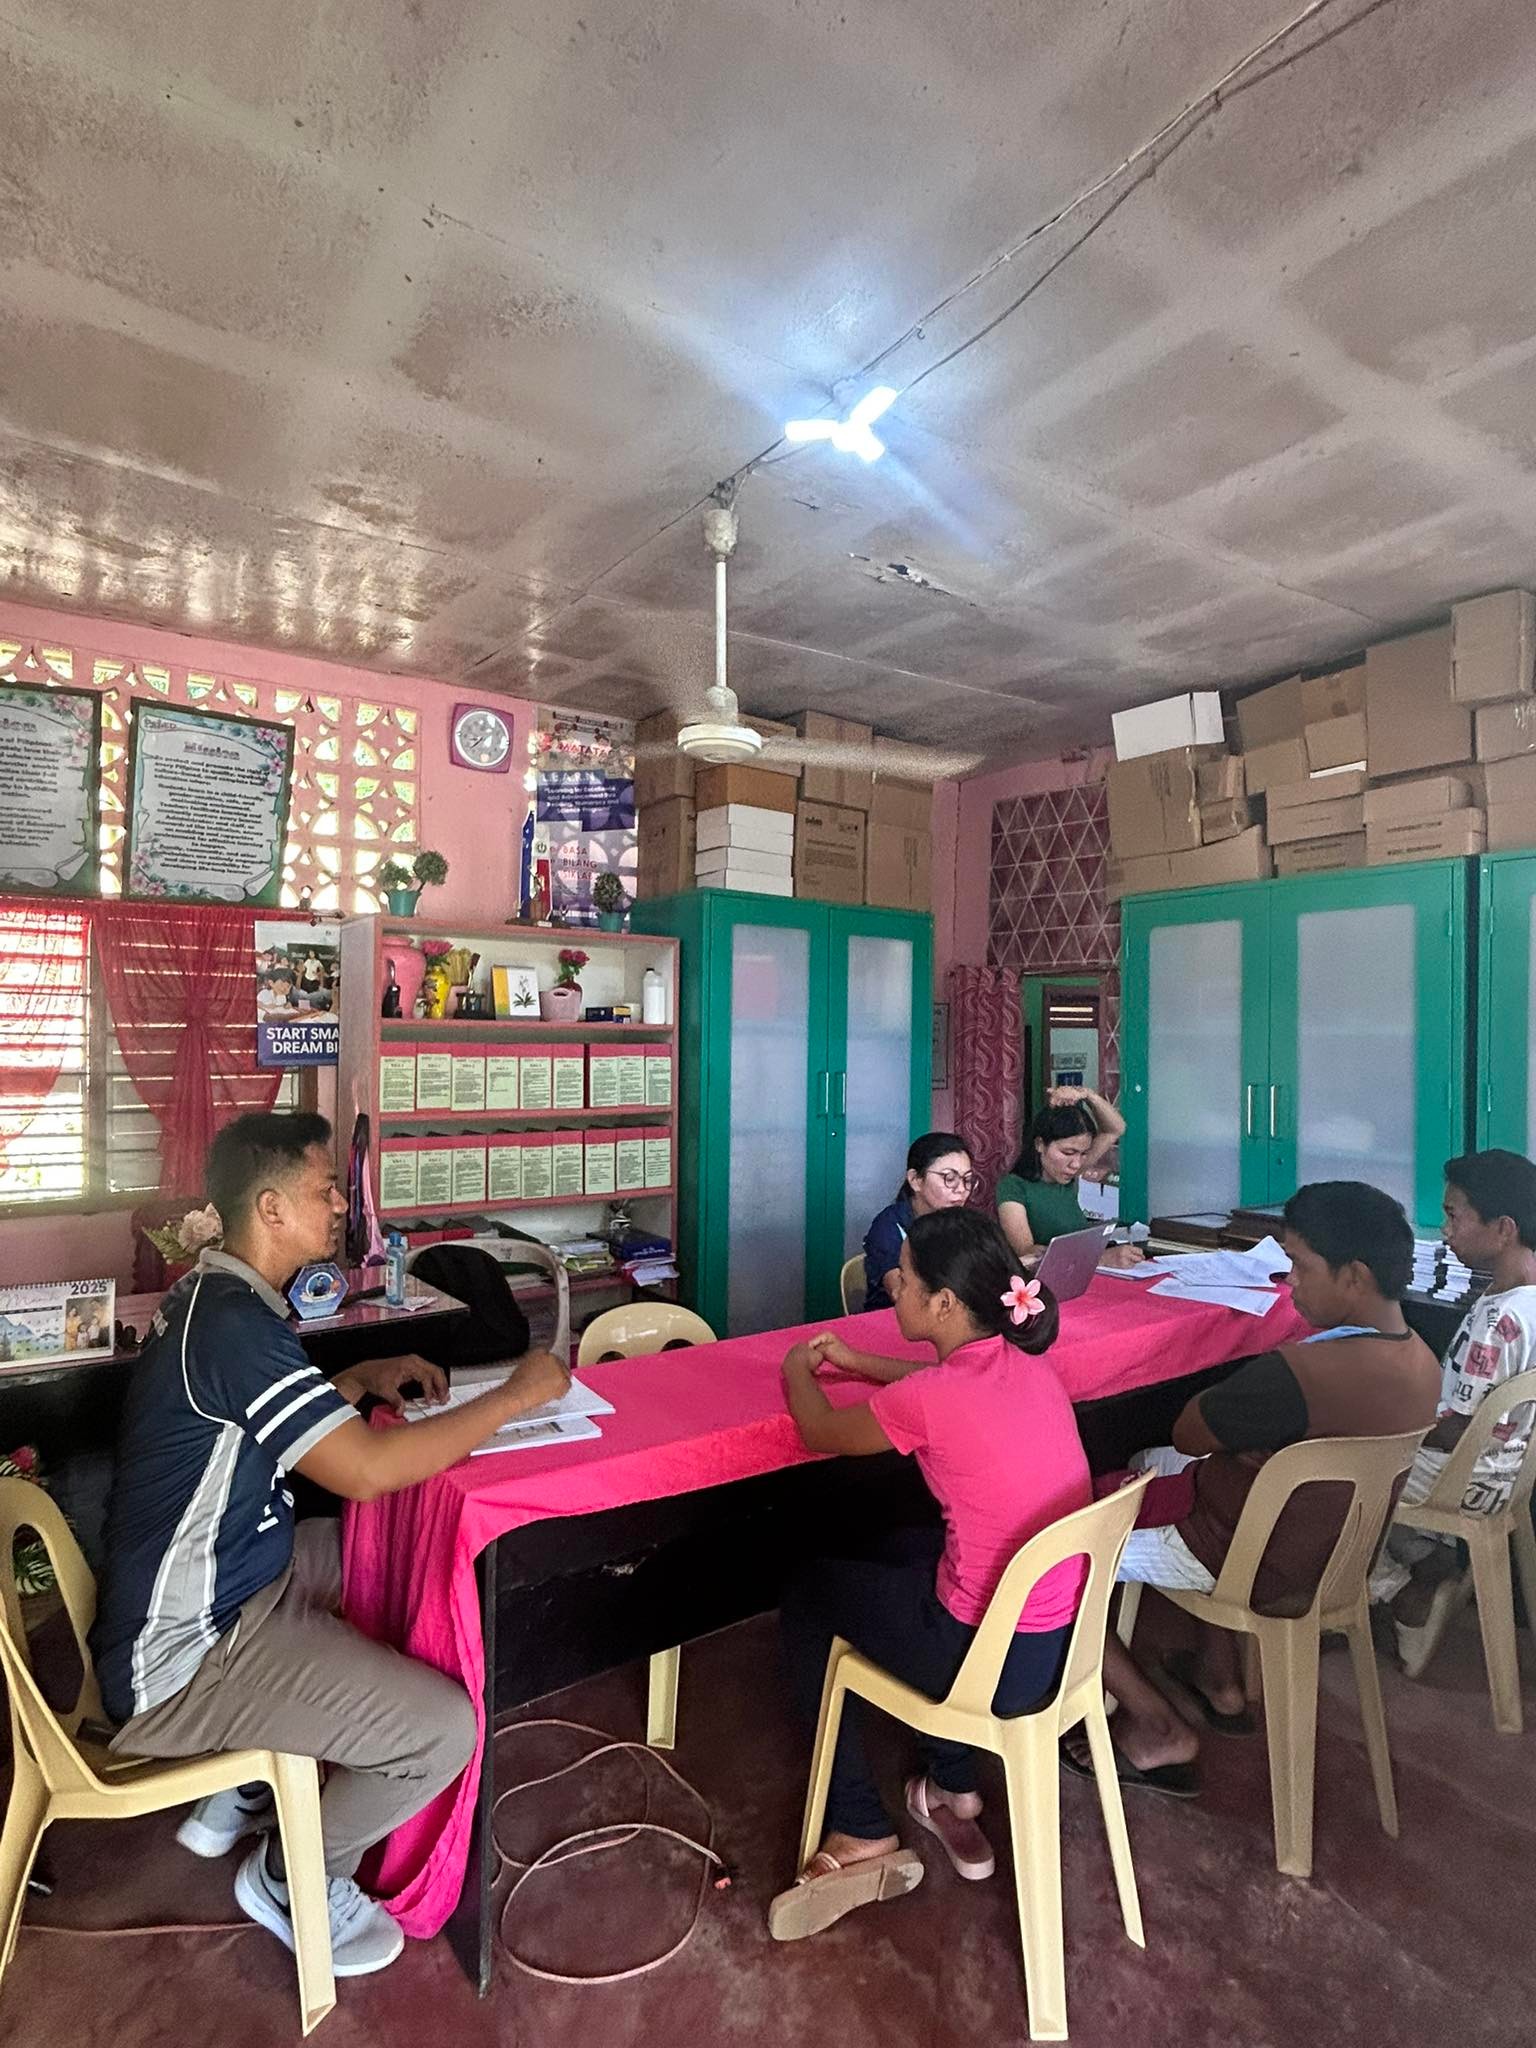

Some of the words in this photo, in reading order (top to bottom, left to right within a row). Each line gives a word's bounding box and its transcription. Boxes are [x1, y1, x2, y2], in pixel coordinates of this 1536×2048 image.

[266, 1027, 307, 1040] START
[310, 1027, 339, 1040] SMA
[273, 1041, 322, 1054] DREAM
[326, 1041, 338, 1054] BI
[70, 1281, 107, 1295] 2025
